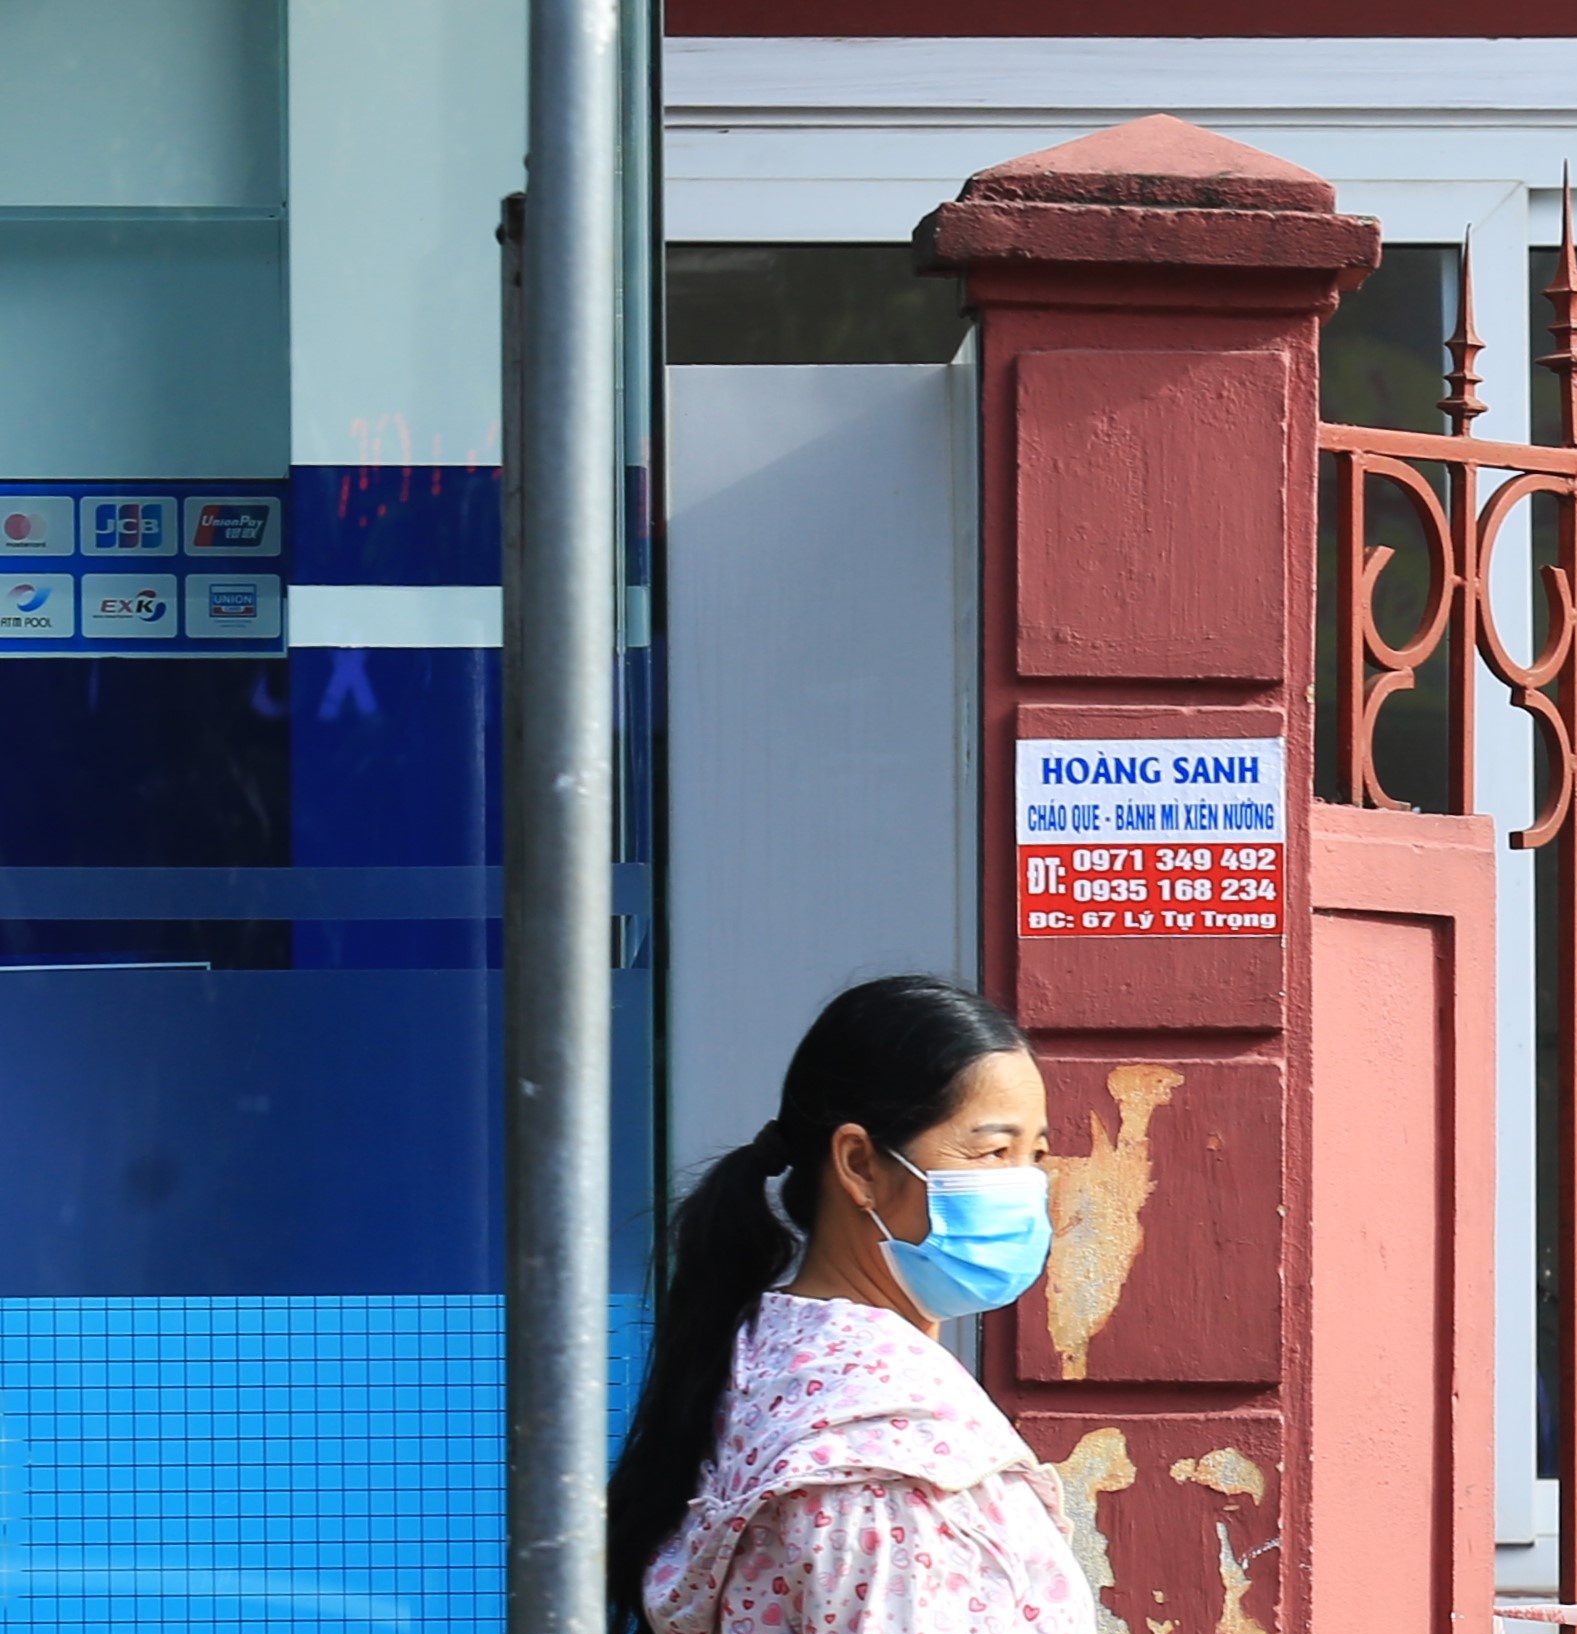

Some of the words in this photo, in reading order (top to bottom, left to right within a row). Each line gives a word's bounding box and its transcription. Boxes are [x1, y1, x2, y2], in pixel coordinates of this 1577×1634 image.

[95, 518, 160, 534] JCB
[202, 515, 264, 528] UnionPay
[100, 599, 154, 613] EXK
[214, 594, 252, 604] UNION
[24, 617, 52, 628] POOL
[1041, 751, 1162, 785] HOÀNG
[1172, 756, 1260, 784] SANH
[1027, 799, 1067, 832] CHÁO
[1072, 804, 1100, 834] QUE
[1115, 799, 1156, 831] BÁNH
[1160, 798, 1180, 831] MÌ
[1184, 798, 1219, 831] XIÊN
[1223, 796, 1275, 831] NƯỚNG
[1072, 848, 1144, 872] 0971
[1155, 848, 1212, 872] 349
[1220, 848, 1277, 871] 492
[1026, 856, 1067, 895] ĐT:
[1072, 879, 1148, 902] 0935
[1157, 879, 1212, 901] 168
[1220, 879, 1277, 901] 234
[1028, 911, 1075, 929] ĐC:
[1082, 911, 1116, 928] 67
[1123, 910, 1155, 930] Lý
[1161, 910, 1195, 931] Tự
[1200, 910, 1277, 931] Trọng
